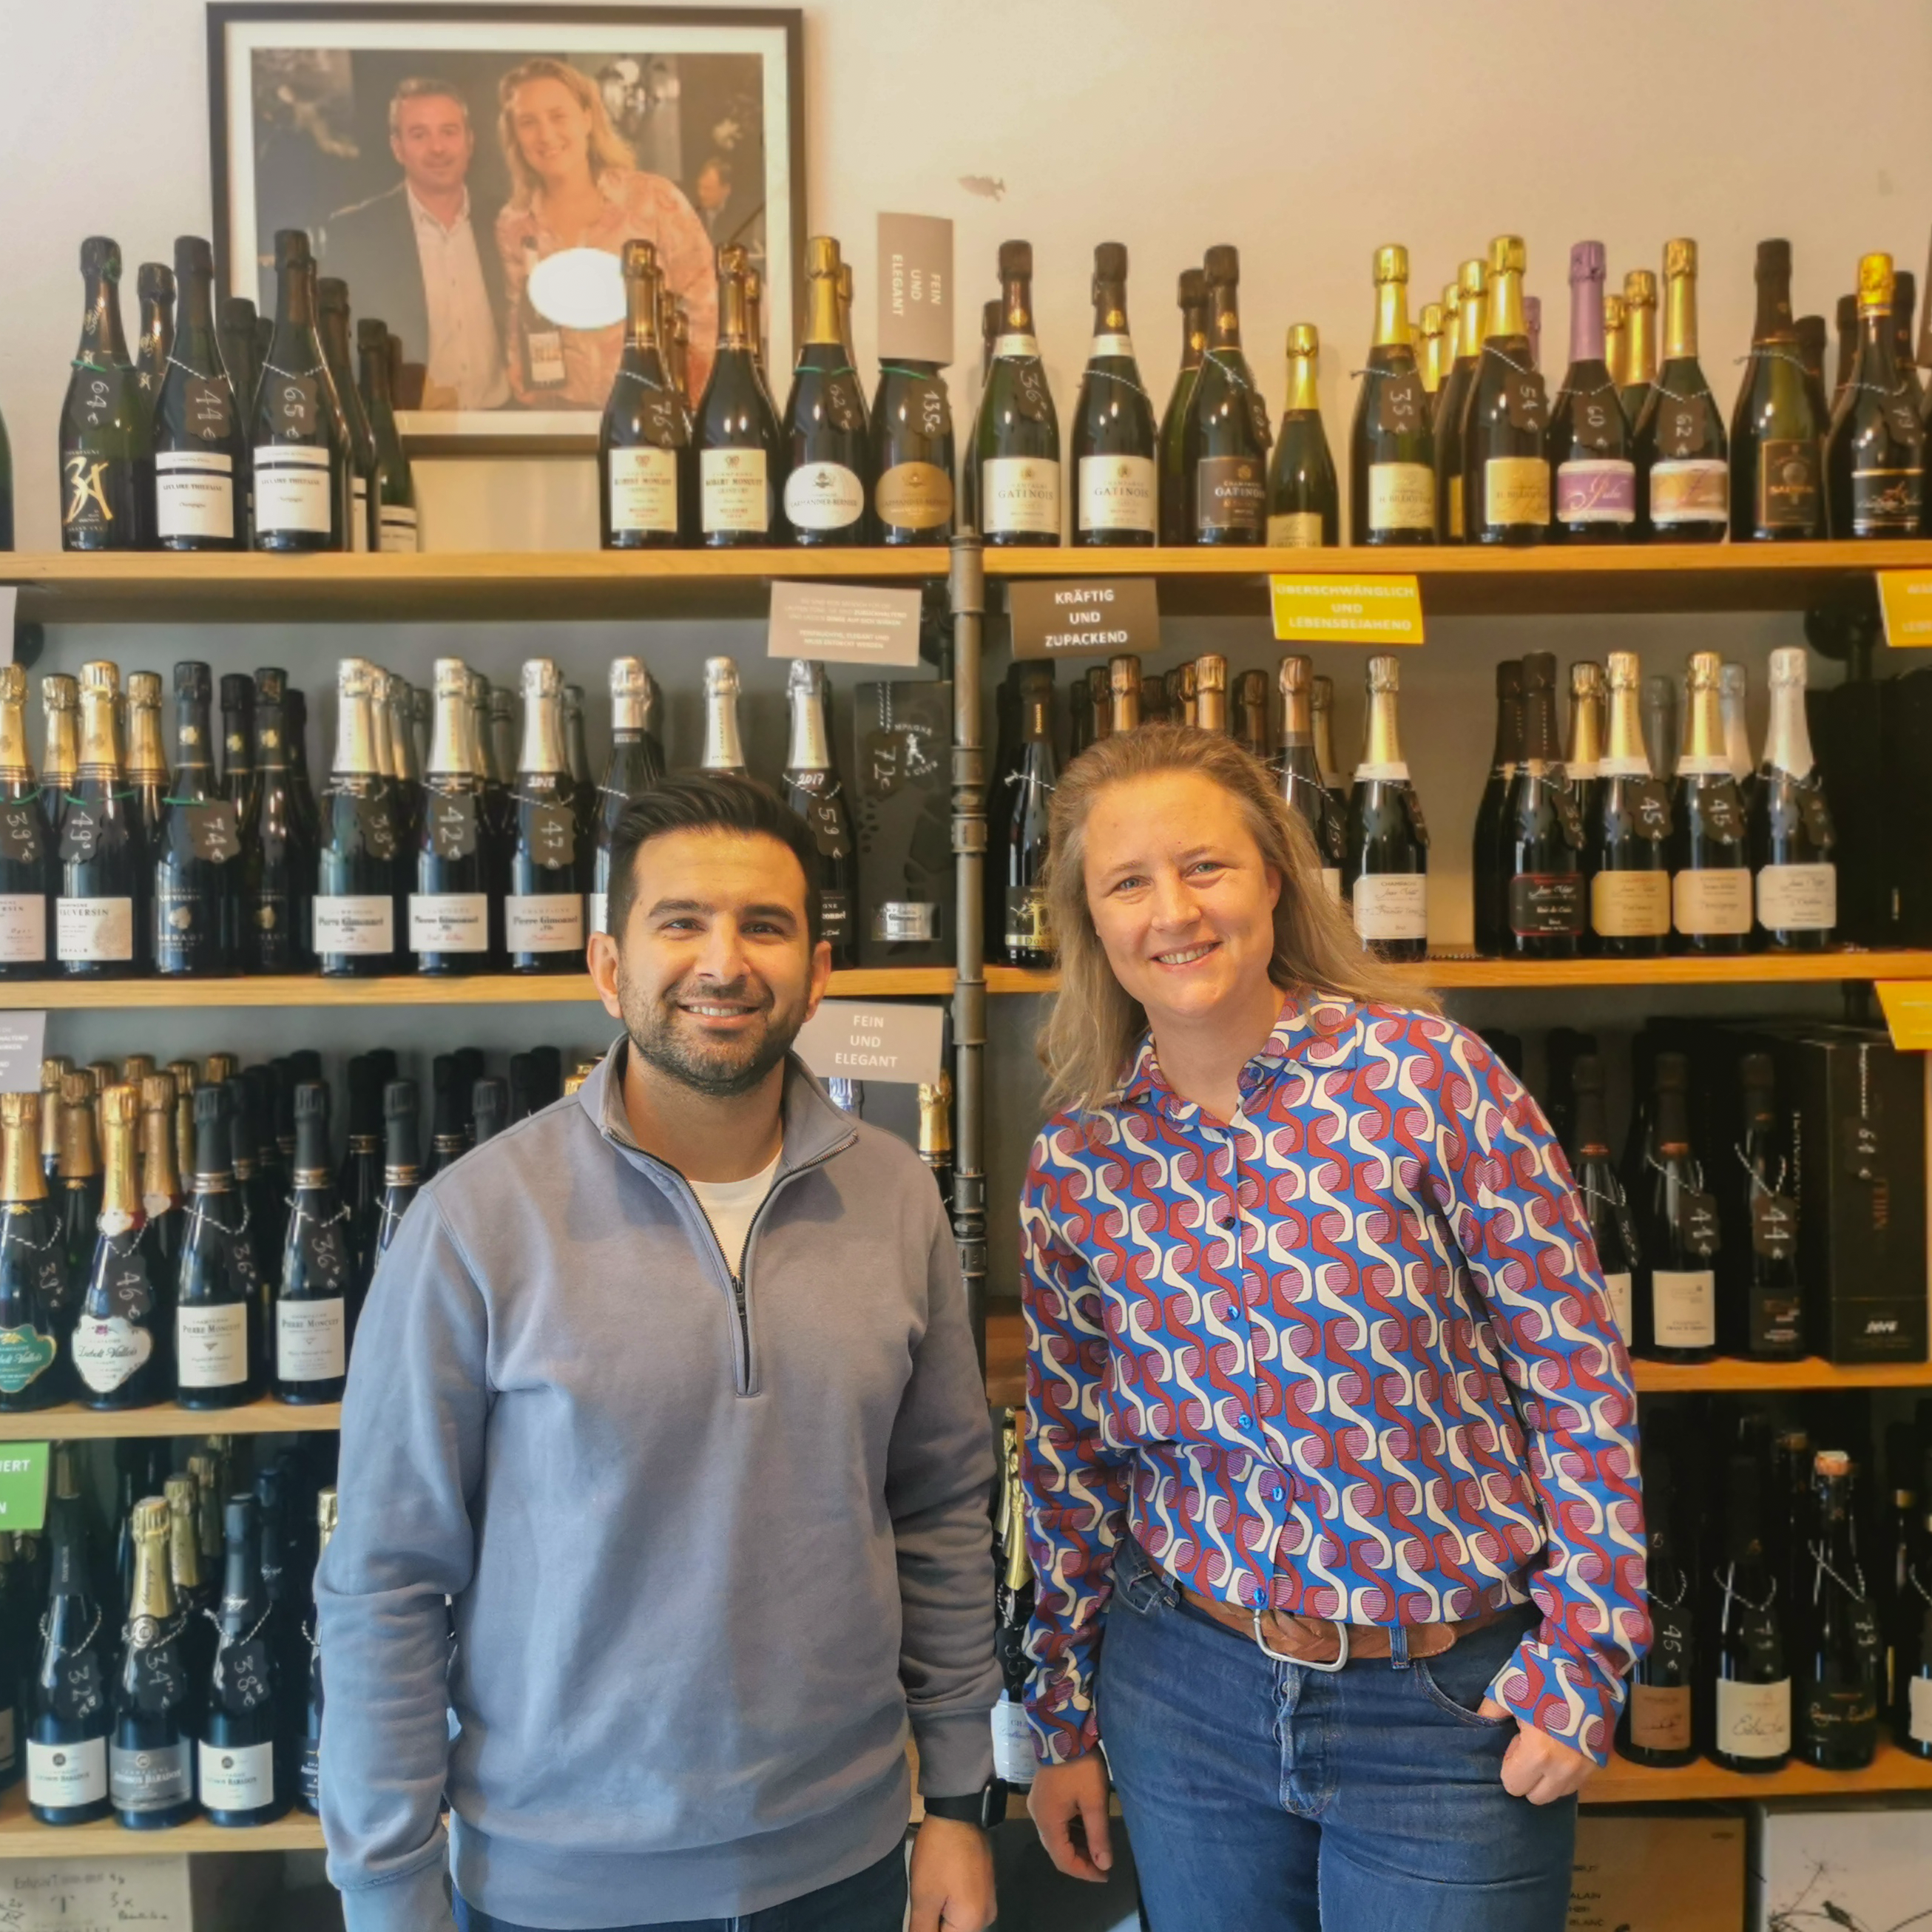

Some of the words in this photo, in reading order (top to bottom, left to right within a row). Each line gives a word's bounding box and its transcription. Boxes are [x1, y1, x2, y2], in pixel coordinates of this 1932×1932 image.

[892, 254, 904, 317] ELEGANT
[911, 269, 922, 301] UND
[930, 273, 942, 305] FEIN
[87, 380, 109, 409] 64
[828, 384, 845, 408] 62
[1020, 371, 1041, 402] 36
[1520, 385, 1538, 411] 54
[195, 389, 223, 420] 44
[284, 387, 305, 419] 65
[1390, 388, 1413, 416] 35
[1587, 405, 1605, 427] 60
[1675, 414, 1692, 437] 62
[998, 489, 1054, 501] GATINOIS
[1094, 487, 1149, 499] GATINOIS
[1215, 487, 1266, 499] GATINOIS
[1055, 589, 1115, 604] KRÄFTIG
[1275, 583, 1415, 598] ÜBERSCHWÄNGLICH
[1069, 611, 1101, 625] UND
[1331, 603, 1363, 614] UND
[1288, 617, 1412, 632] LEBENSBEJAHEND
[1044, 630, 1128, 648] ZUPACKEND
[874, 746, 896, 780] 72
[797, 773, 825, 786] 2017
[439, 805, 465, 842] 42
[818, 806, 840, 835] 59
[1640, 797, 1665, 825] 45
[1709, 799, 1730, 827] 45
[6, 811, 33, 840] 39
[70, 811, 93, 841] 49
[202, 817, 227, 845] 74
[541, 820, 564, 848] 47
[853, 1015, 885, 1028] FEIN
[850, 1035, 882, 1048] UND
[834, 1052, 898, 1068] ELEGANT
[234, 1243, 254, 1273] 36
[312, 1234, 337, 1269] 36
[116, 1271, 143, 1300] 46
[1663, 1624, 1683, 1652] 45
[146, 1652, 171, 1685] 34
[234, 1655, 257, 1692] 38
